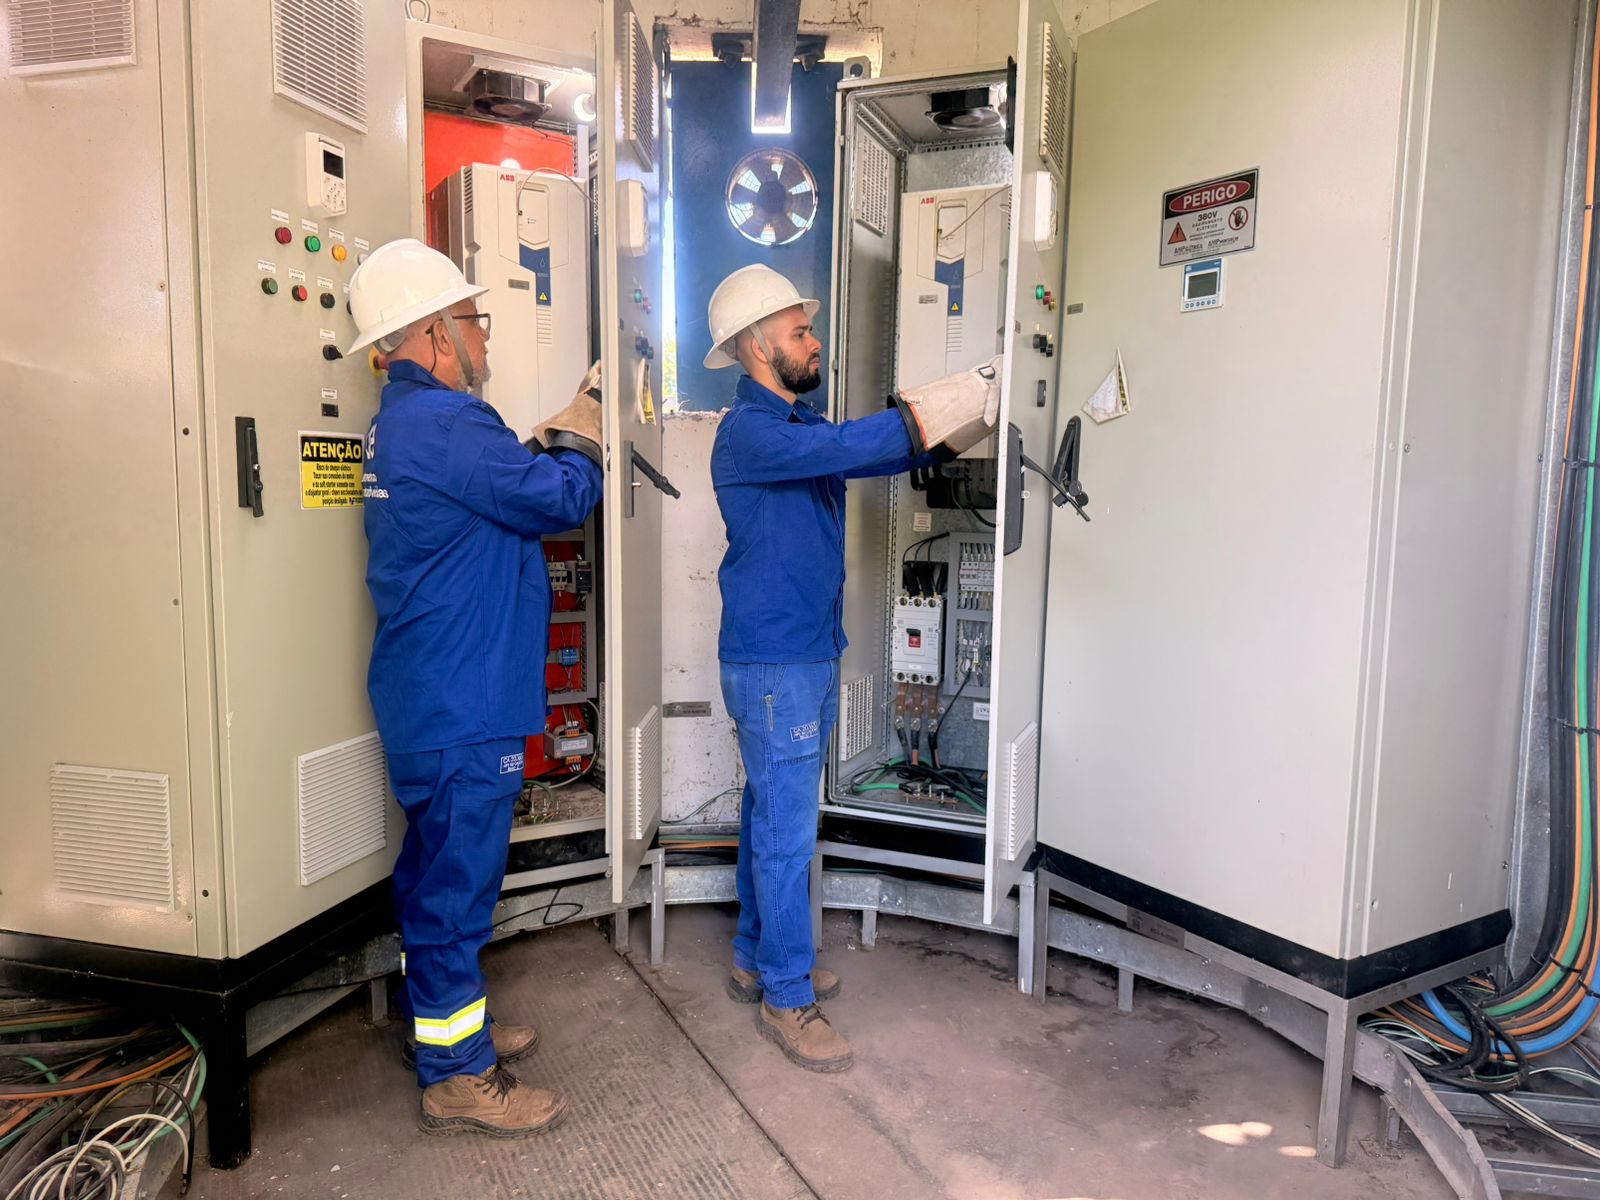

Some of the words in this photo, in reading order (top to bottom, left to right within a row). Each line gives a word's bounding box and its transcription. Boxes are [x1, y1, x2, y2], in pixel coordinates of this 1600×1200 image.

[500, 174, 515, 182] ABB
[921, 197, 934, 205] ABB
[1183, 184, 1237, 209] PERIGO
[1198, 210, 1218, 222] 380V
[303, 440, 362, 462] ATENÇÃO
